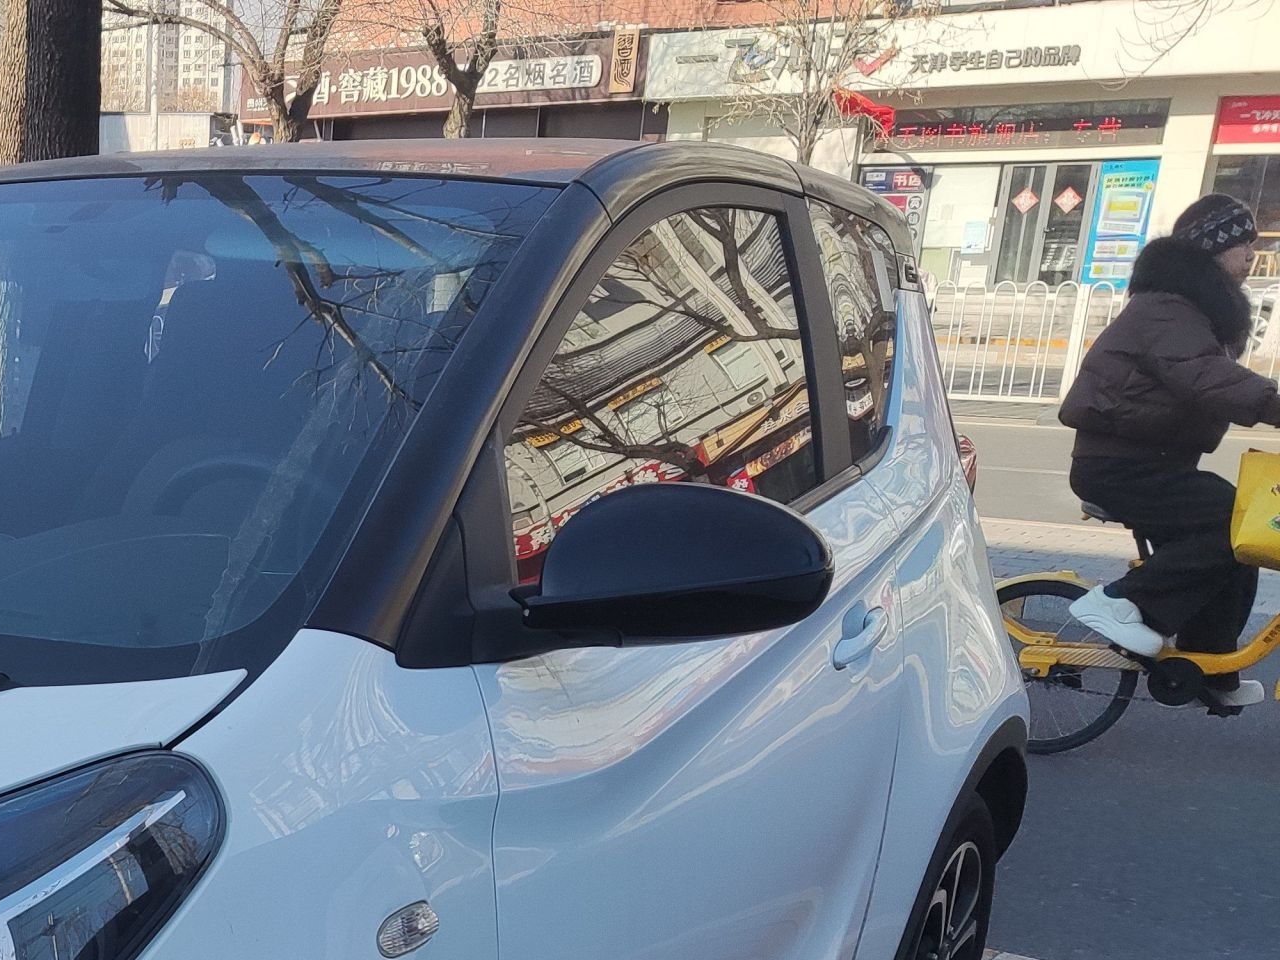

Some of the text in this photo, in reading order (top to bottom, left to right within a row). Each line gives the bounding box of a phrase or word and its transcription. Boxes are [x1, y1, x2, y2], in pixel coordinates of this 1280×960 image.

[910, 45, 1081, 74] 天津学生自己的品牌
[894, 174, 921, 187] 书店
